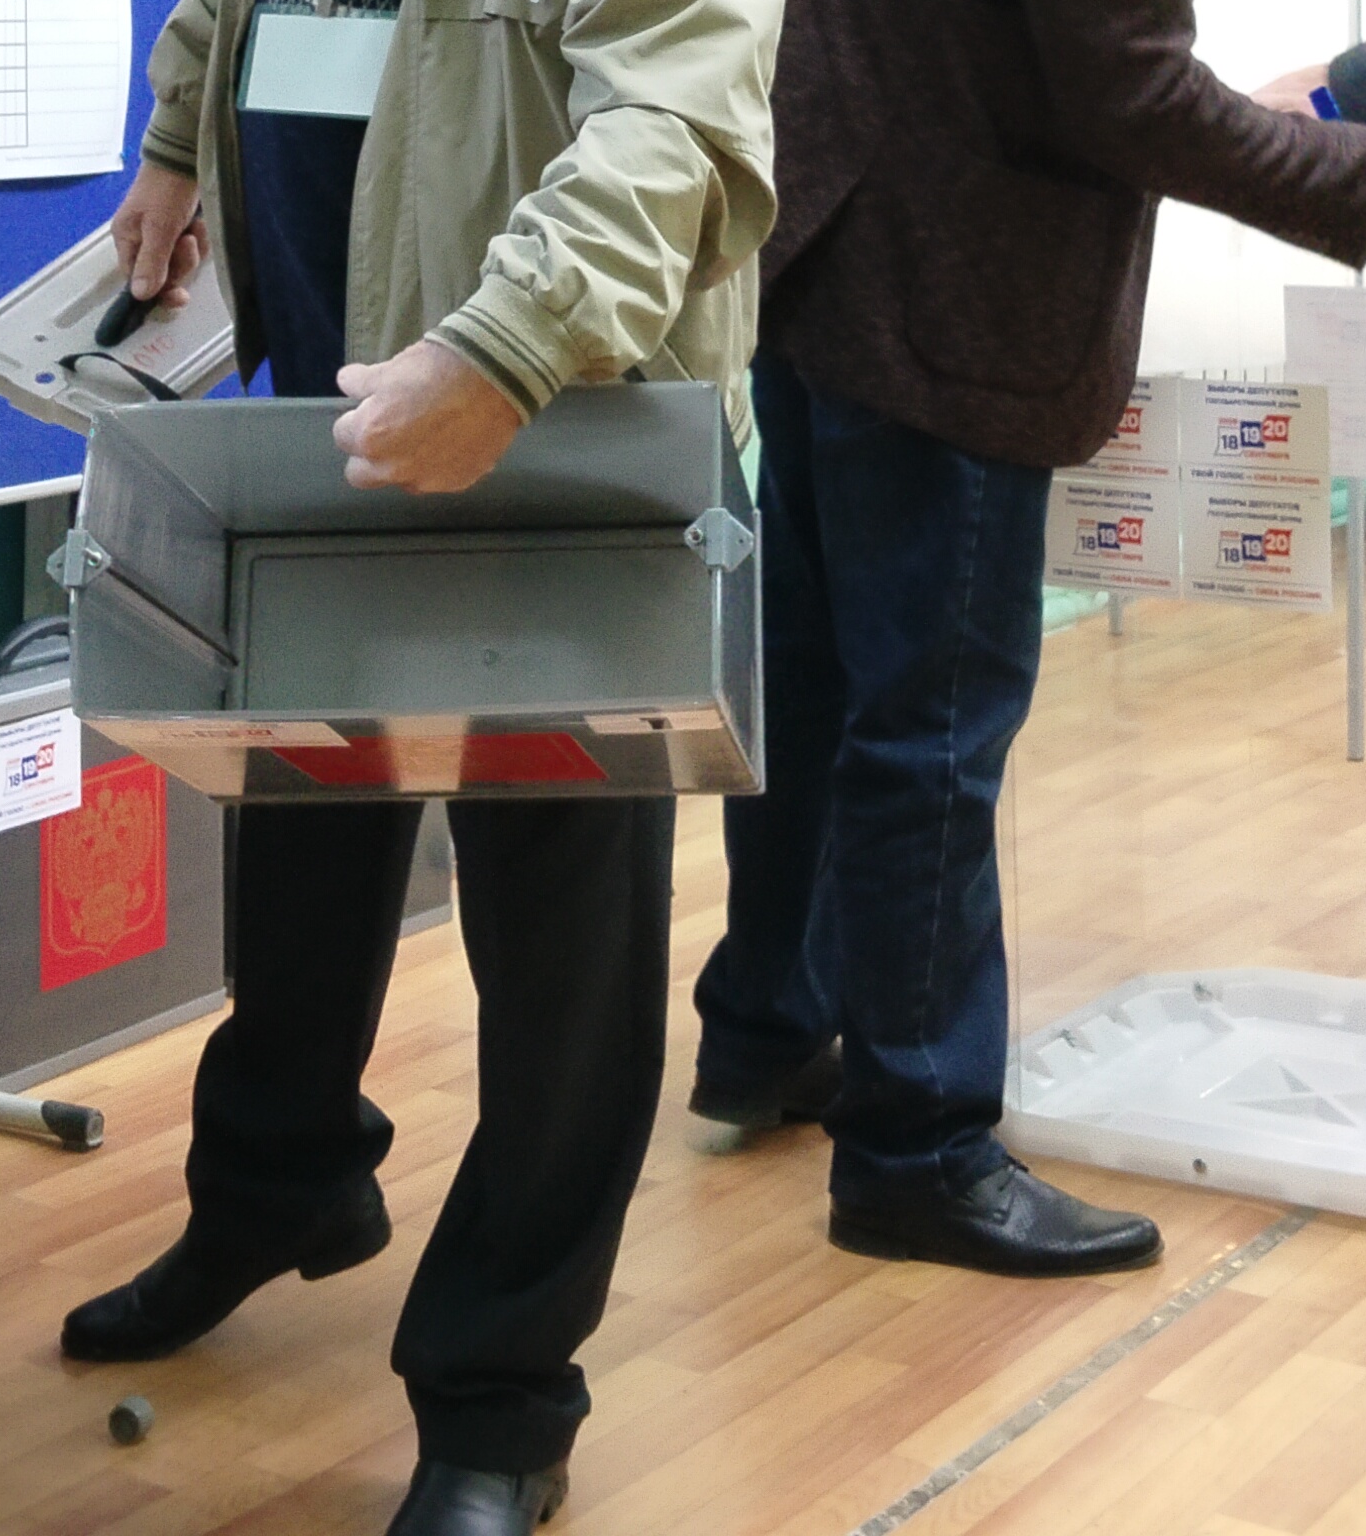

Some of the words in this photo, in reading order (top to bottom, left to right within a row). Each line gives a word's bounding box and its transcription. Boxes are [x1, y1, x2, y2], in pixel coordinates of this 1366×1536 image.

[1221, 435, 1238, 450] 18
[1242, 426, 1261, 444] 19
[1263, 420, 1287, 438] 20
[1079, 536, 1096, 551] 18
[1100, 528, 1116, 544] 19
[1118, 522, 1140, 540] 20
[1223, 547, 1240, 563] 18
[1244, 539, 1262, 557] 19
[1265, 534, 1288, 552] 20
[9, 772, 21, 788] 18
[25, 760, 35, 777] 19
[38, 746, 53, 767] 20
